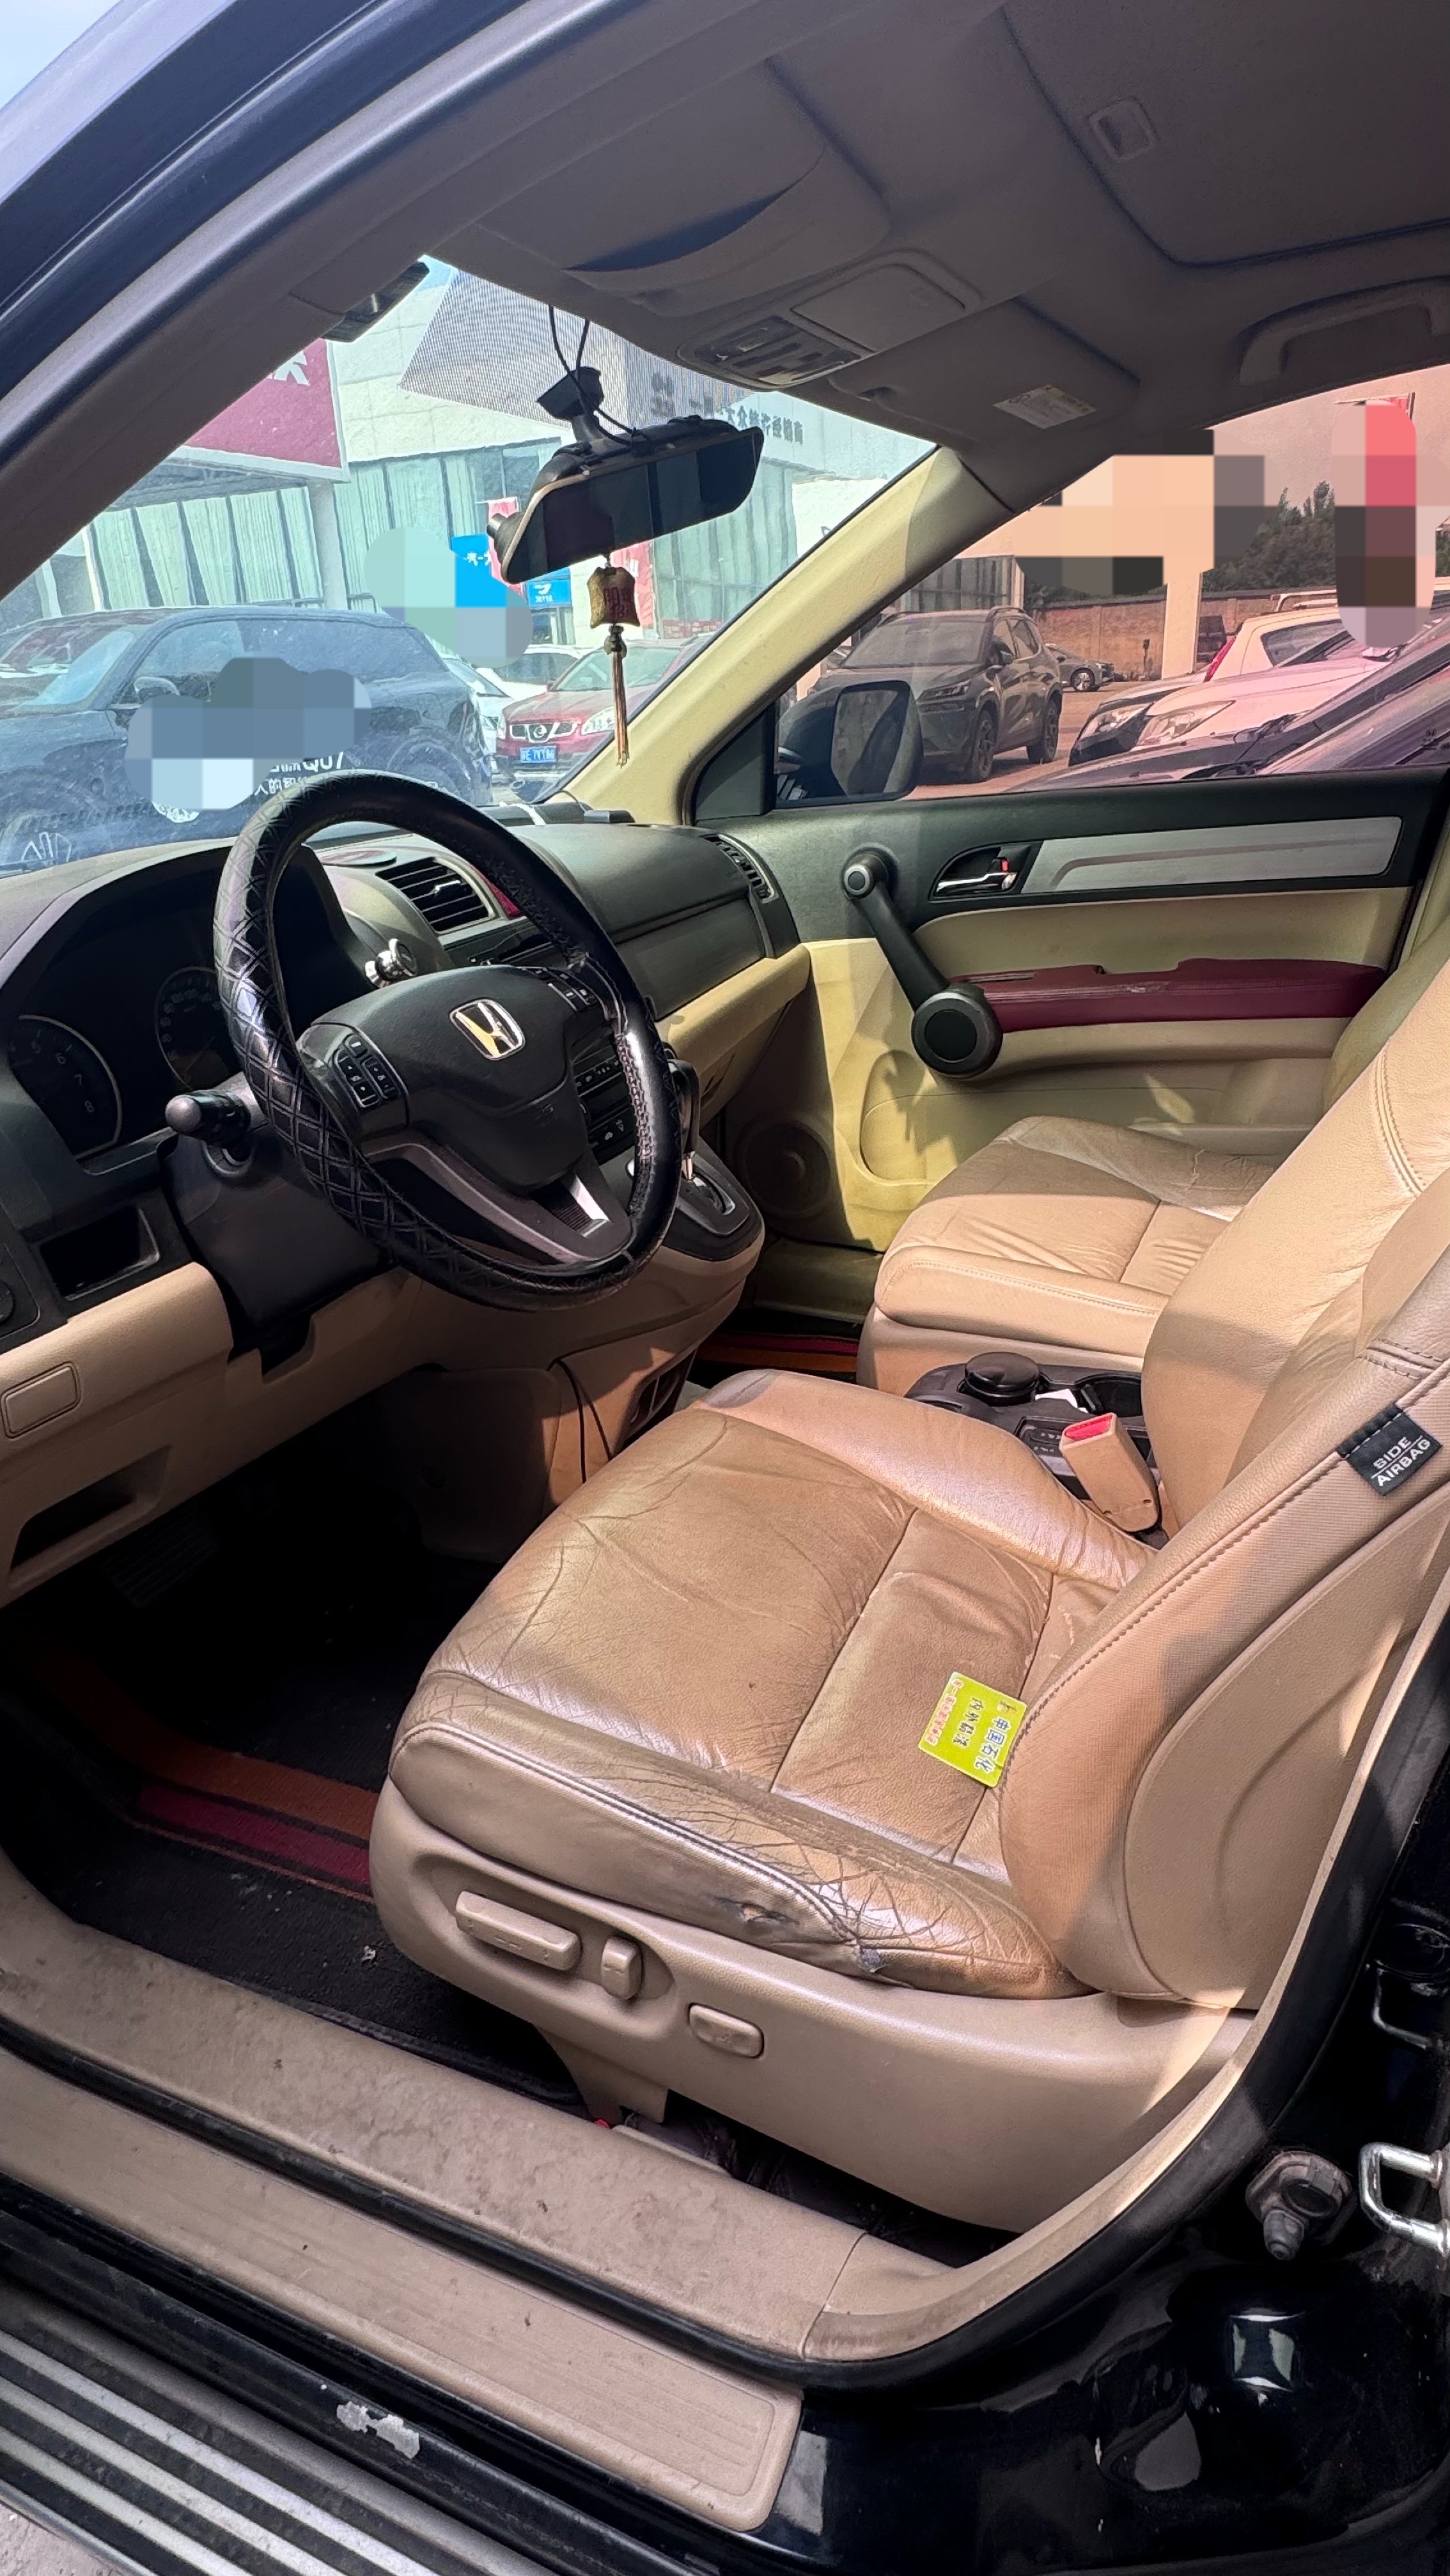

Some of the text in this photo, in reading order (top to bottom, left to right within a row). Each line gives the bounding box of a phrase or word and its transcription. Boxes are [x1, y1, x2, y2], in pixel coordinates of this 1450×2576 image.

[1373, 1436, 1411, 1469] SIDE
[1376, 1439, 1431, 1487] AIRBAG
[974, 1718, 1010, 1773] 中国石化
